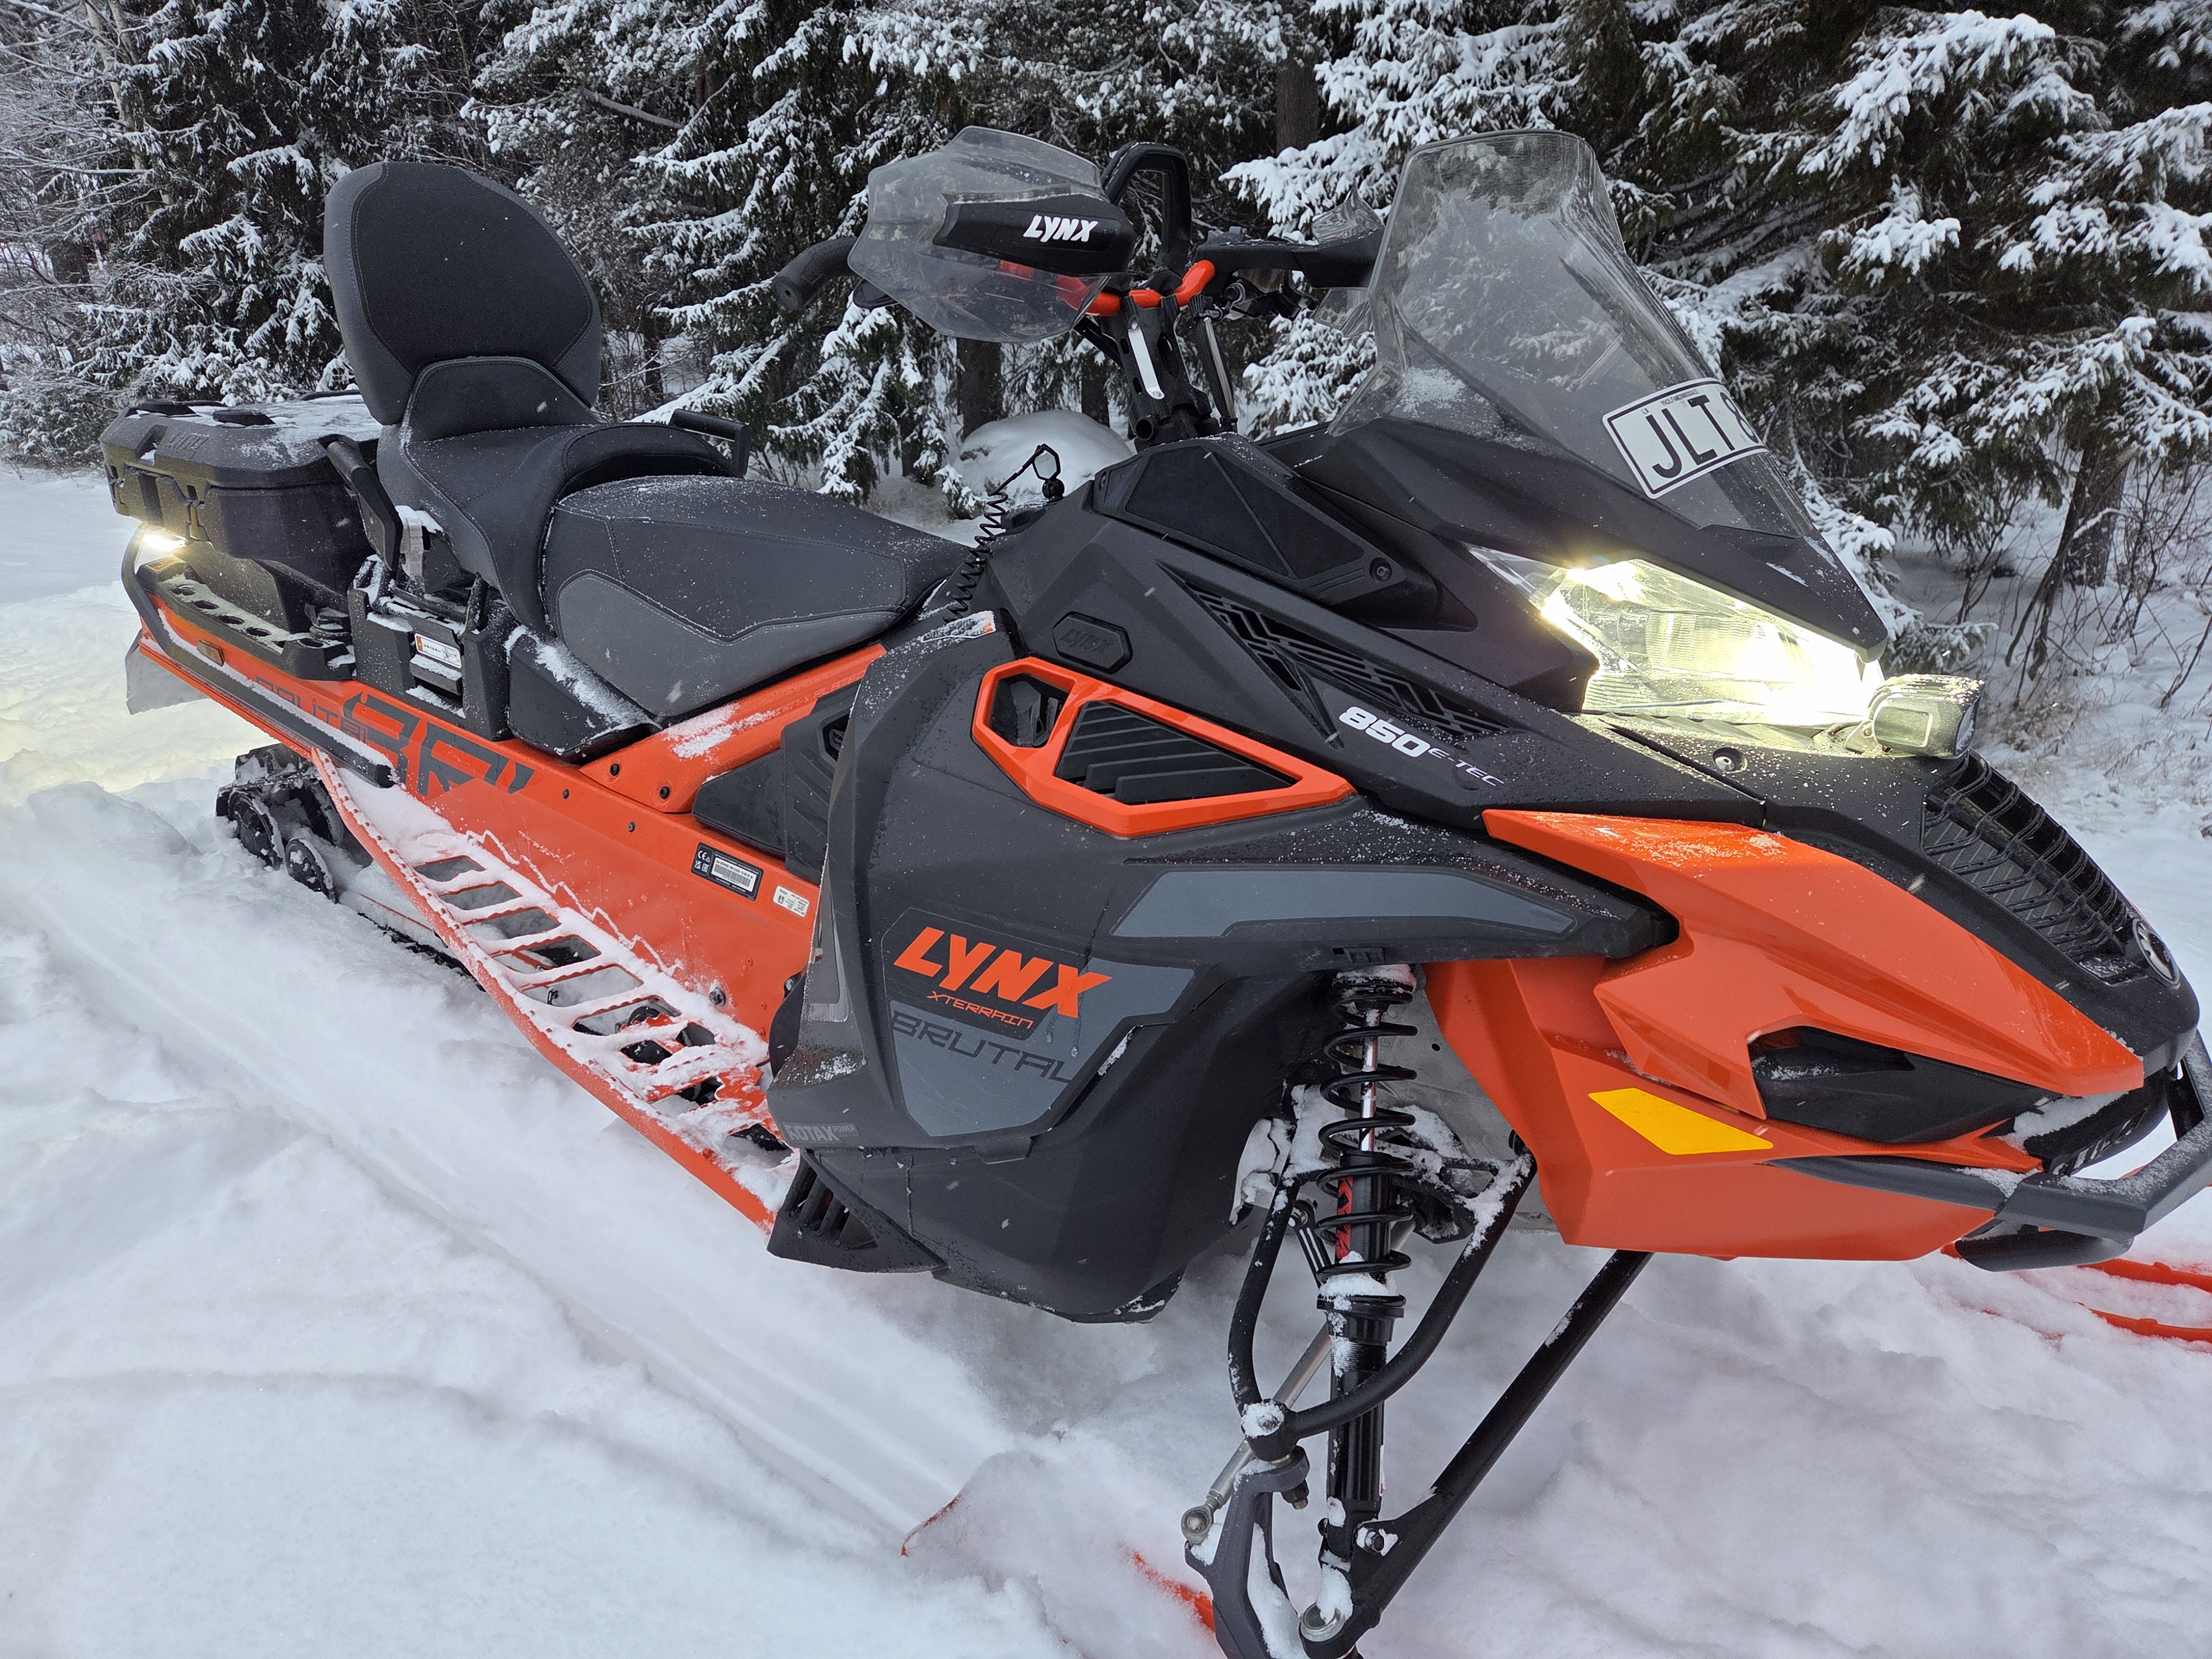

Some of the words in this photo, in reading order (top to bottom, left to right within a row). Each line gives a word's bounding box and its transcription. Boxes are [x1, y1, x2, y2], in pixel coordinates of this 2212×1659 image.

[1022, 213, 1099, 243] LYNX
[1645, 394, 1735, 478] JLT
[1338, 706, 1431, 758] 850
[1428, 748, 1505, 786] E-TEC
[893, 926, 1113, 1019] LYNX
[926, 990, 1034, 1029] XTERRAIN
[890, 1010, 1073, 1084] BRUTAL
[783, 1124, 841, 1141] ROTAX
[832, 1124, 856, 1133] POWER
